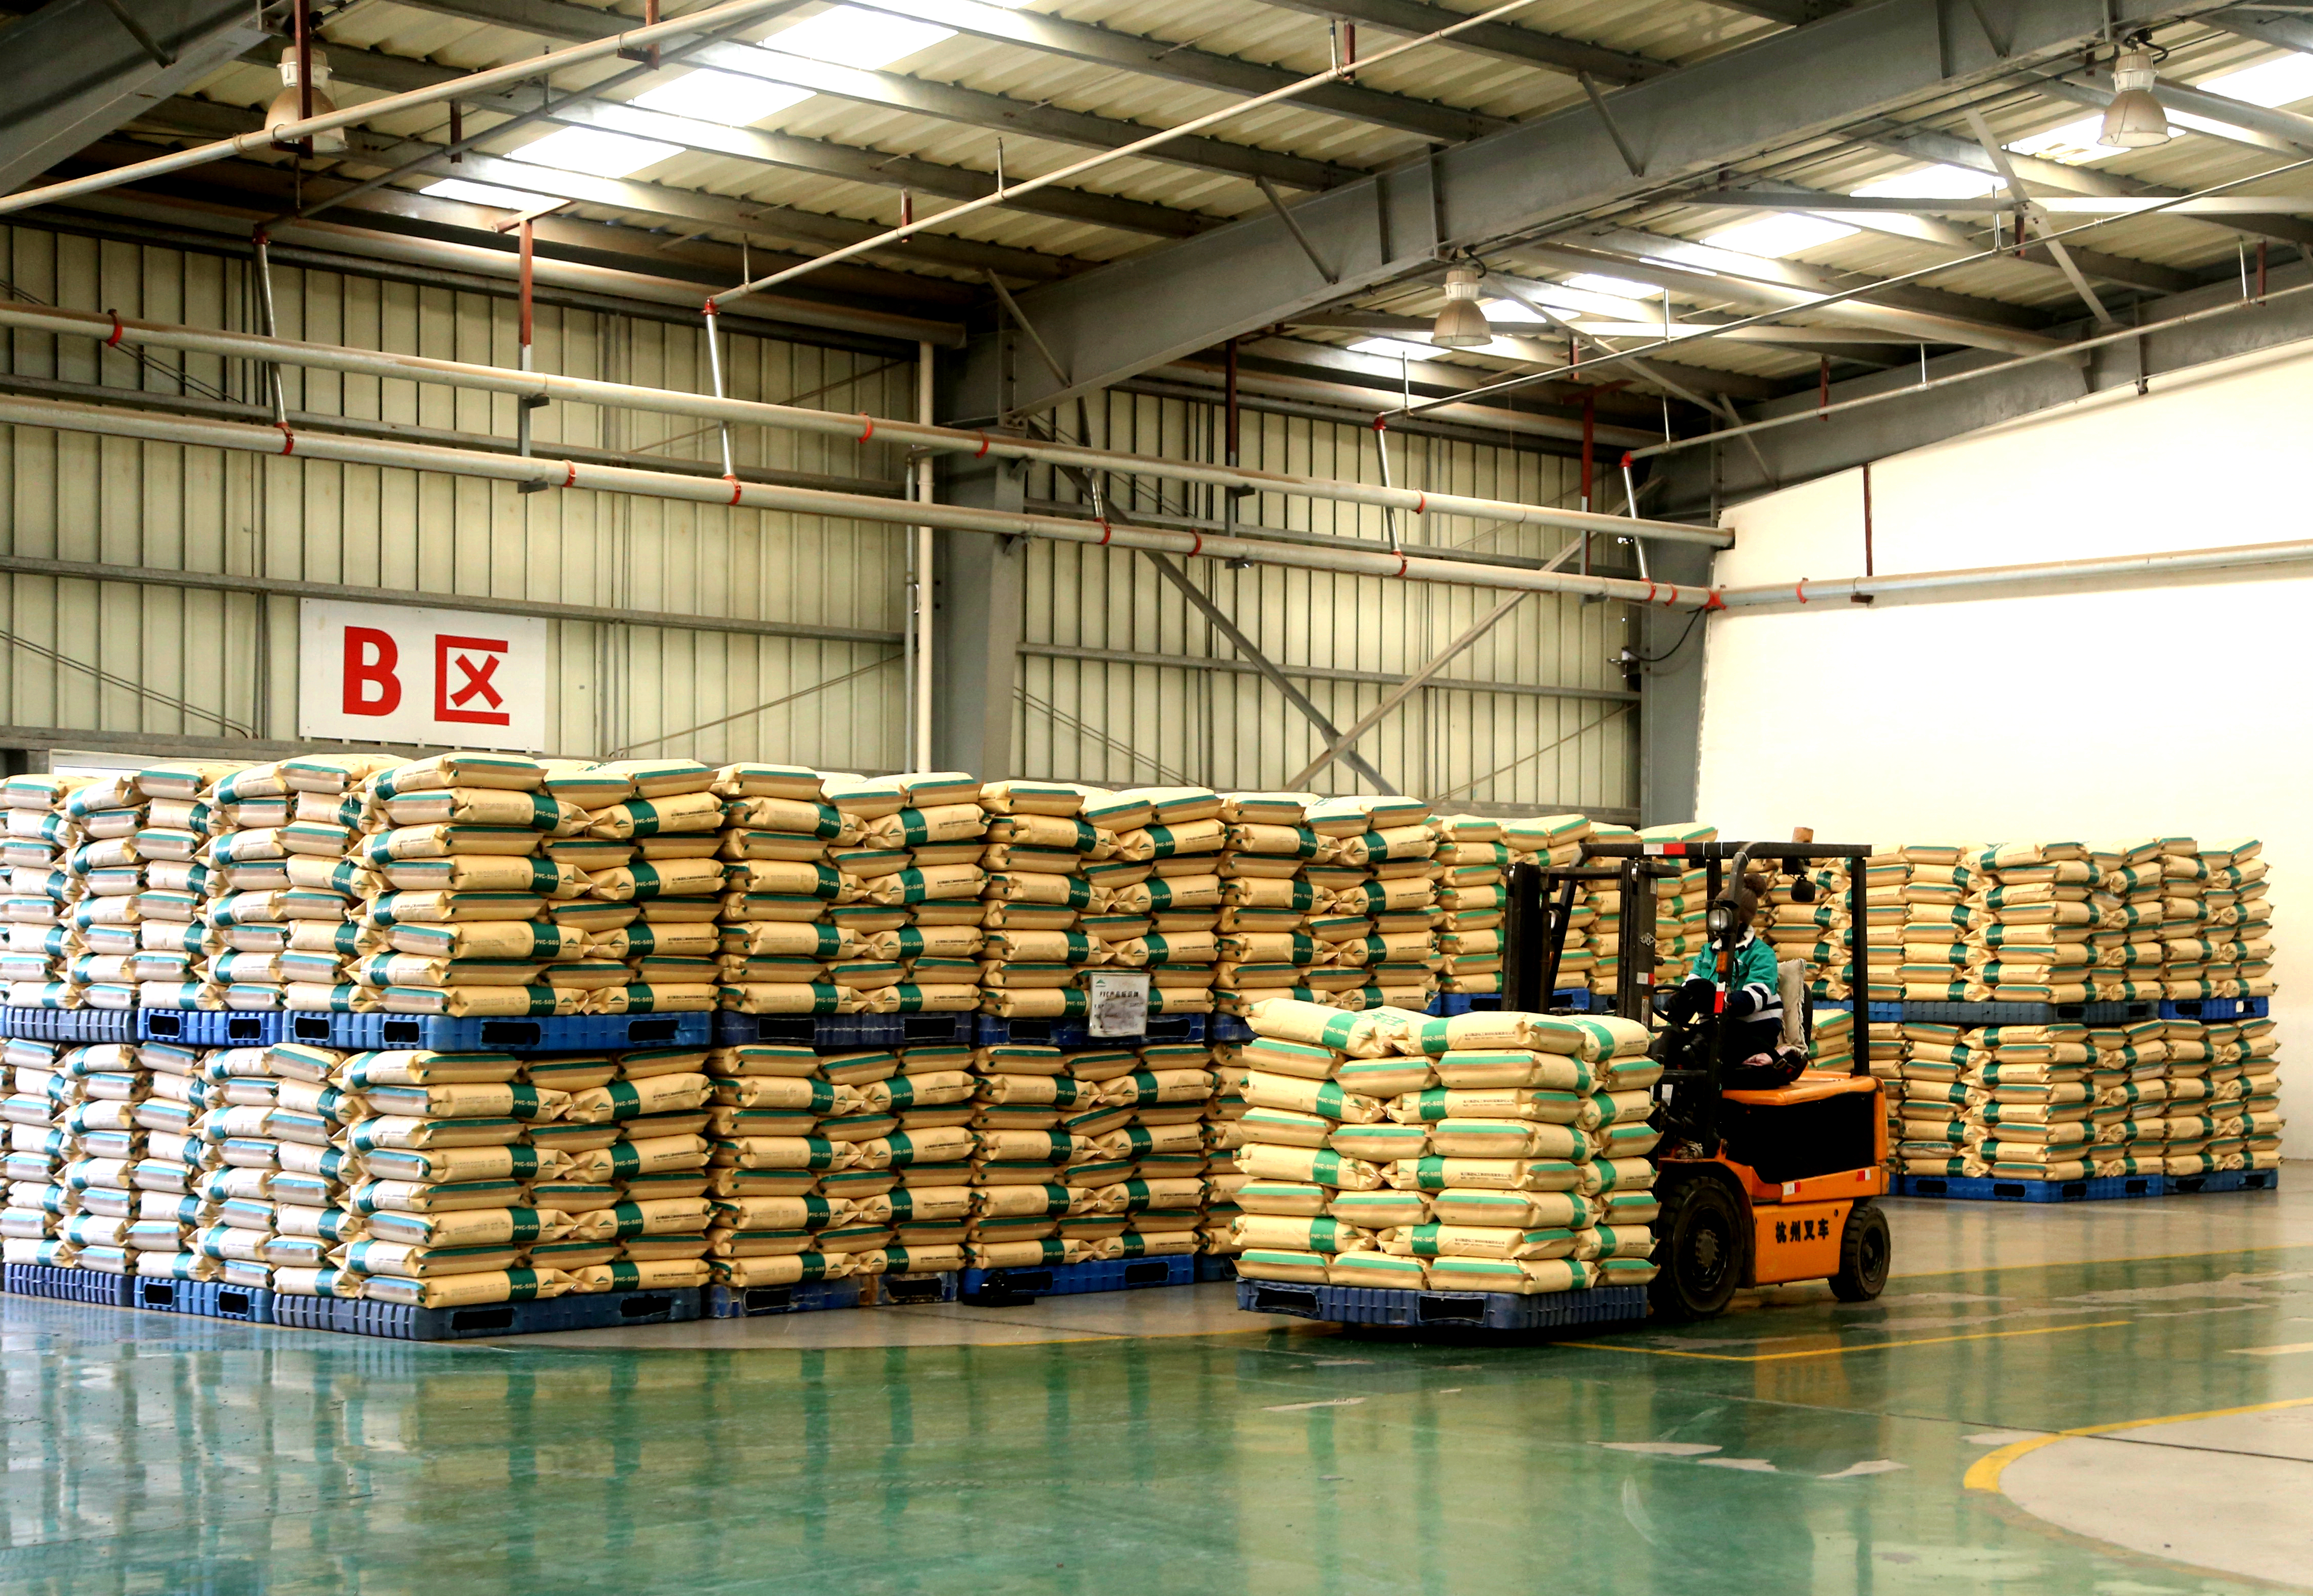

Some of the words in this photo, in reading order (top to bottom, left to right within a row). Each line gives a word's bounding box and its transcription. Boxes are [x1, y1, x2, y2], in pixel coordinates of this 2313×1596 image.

[343, 626, 401, 716] B
[434, 634, 509, 726] 区
[1776, 1218, 1829, 1243] 杭州叉车
